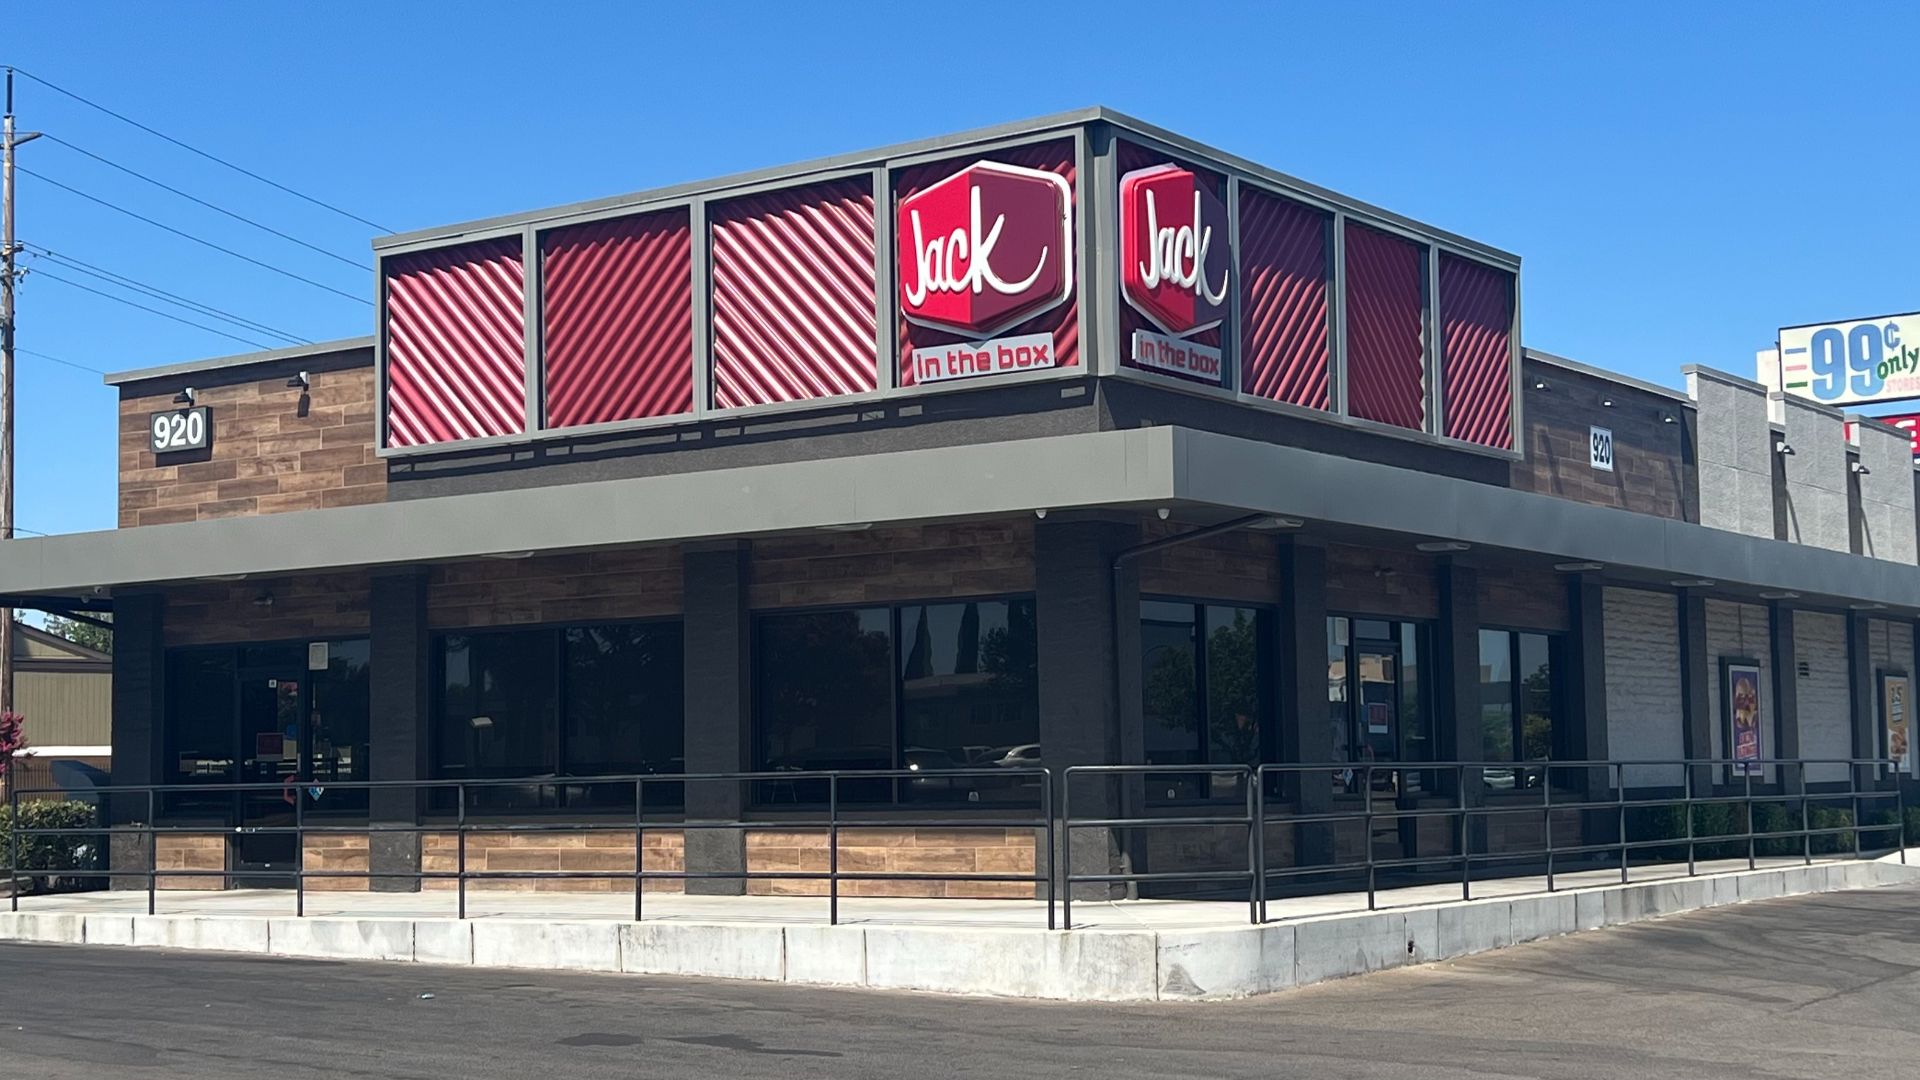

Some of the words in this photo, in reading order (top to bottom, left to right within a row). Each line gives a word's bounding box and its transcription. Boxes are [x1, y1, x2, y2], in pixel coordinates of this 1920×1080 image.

[905, 185, 1048, 307] Jack
[1139, 188, 1229, 306] Jack
[916, 353, 941, 379] in
[946, 349, 991, 376] the
[997, 344, 1049, 370] box
[1140, 334, 1155, 361] in
[1158, 339, 1186, 368] the
[1189, 347, 1219, 376] box
[1876, 344, 1920, 379] only
[154, 411, 203, 449] 920
[1592, 432, 1611, 465] 920
